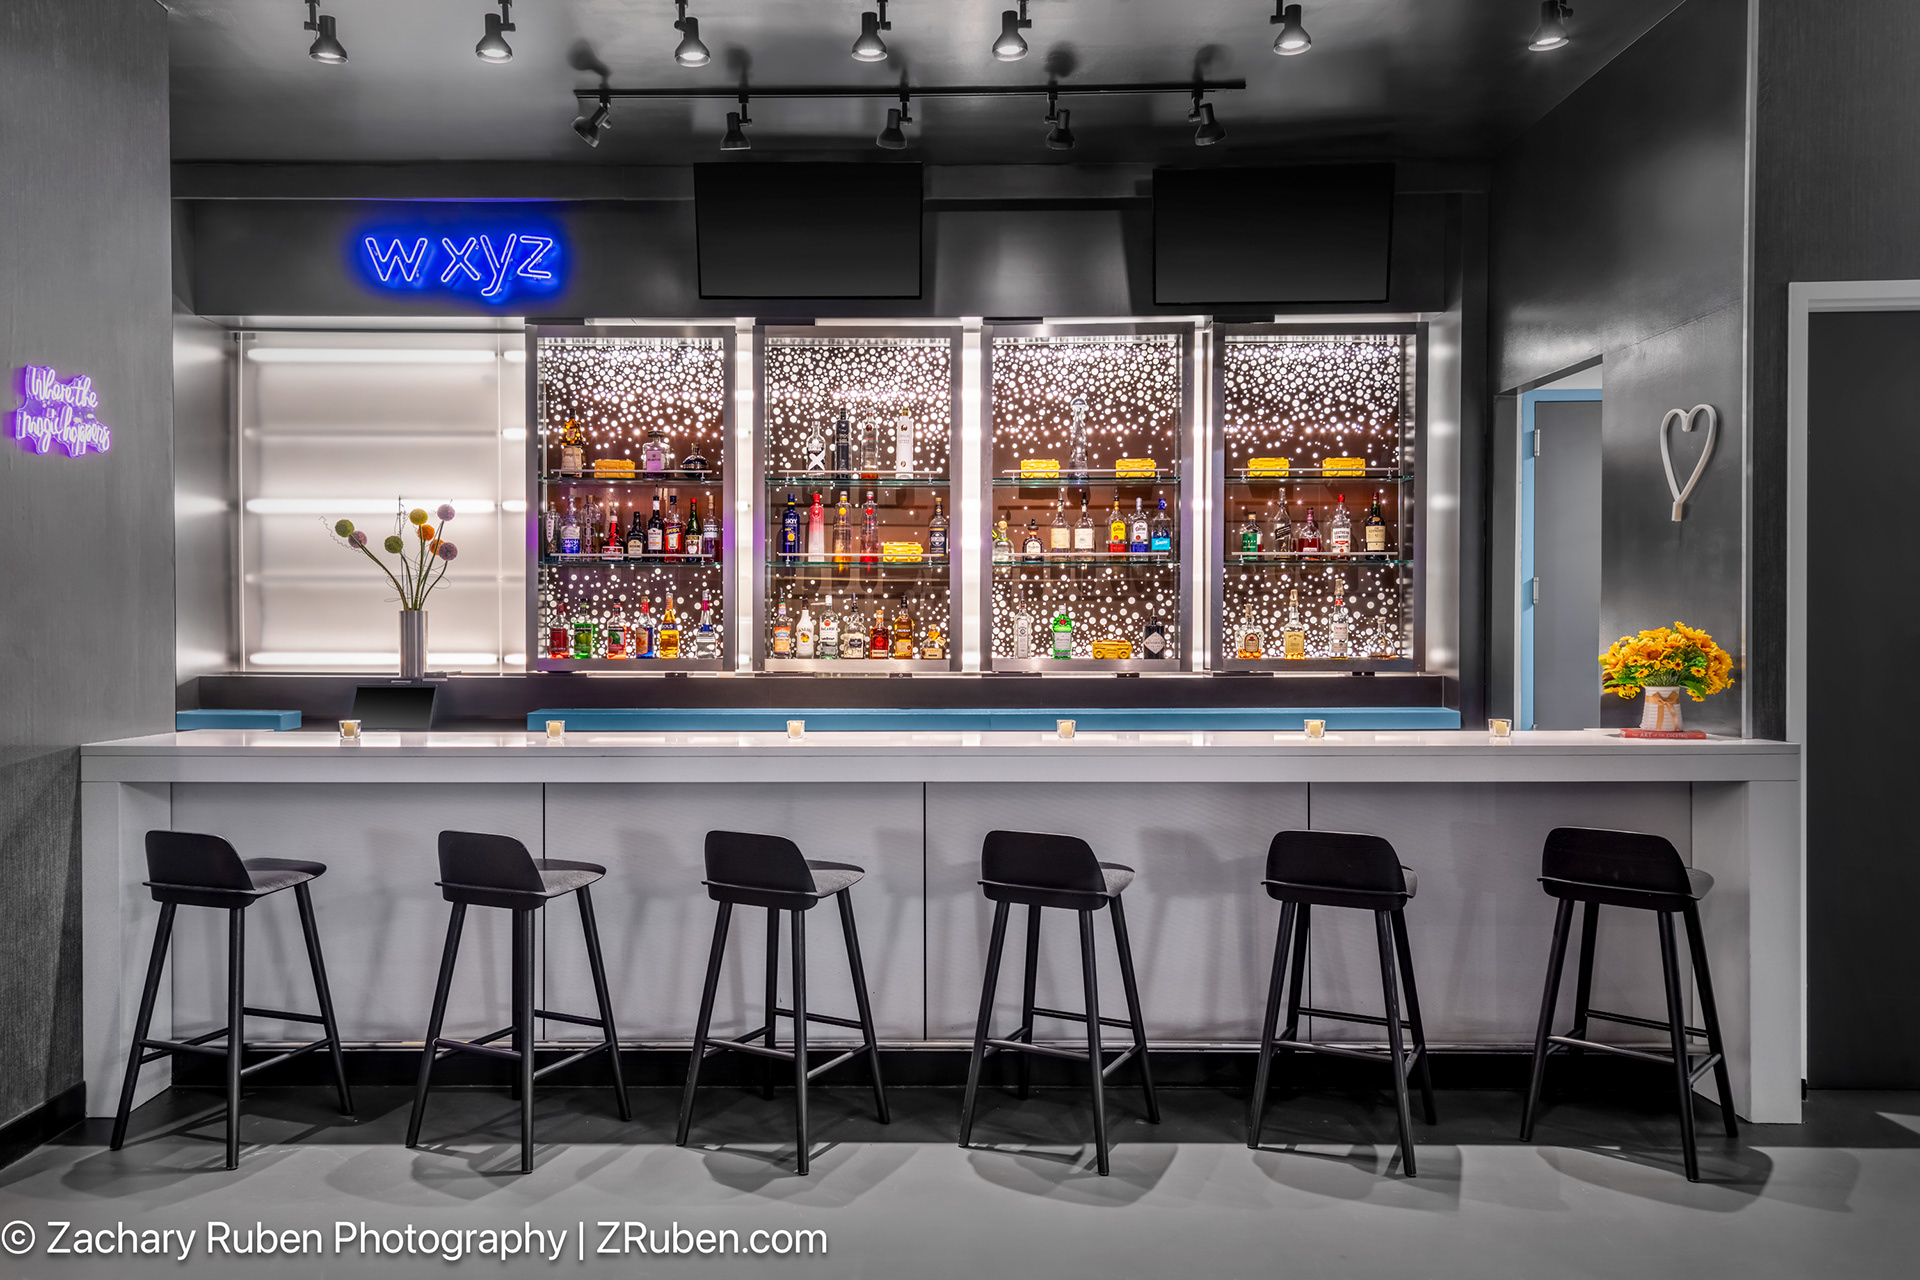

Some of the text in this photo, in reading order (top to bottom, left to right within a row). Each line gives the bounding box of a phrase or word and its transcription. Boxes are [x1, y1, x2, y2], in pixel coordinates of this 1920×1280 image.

[441, 233, 554, 297] xyz
[30, 366, 99, 409] Where the
[18, 405, 111, 456] magic happens
